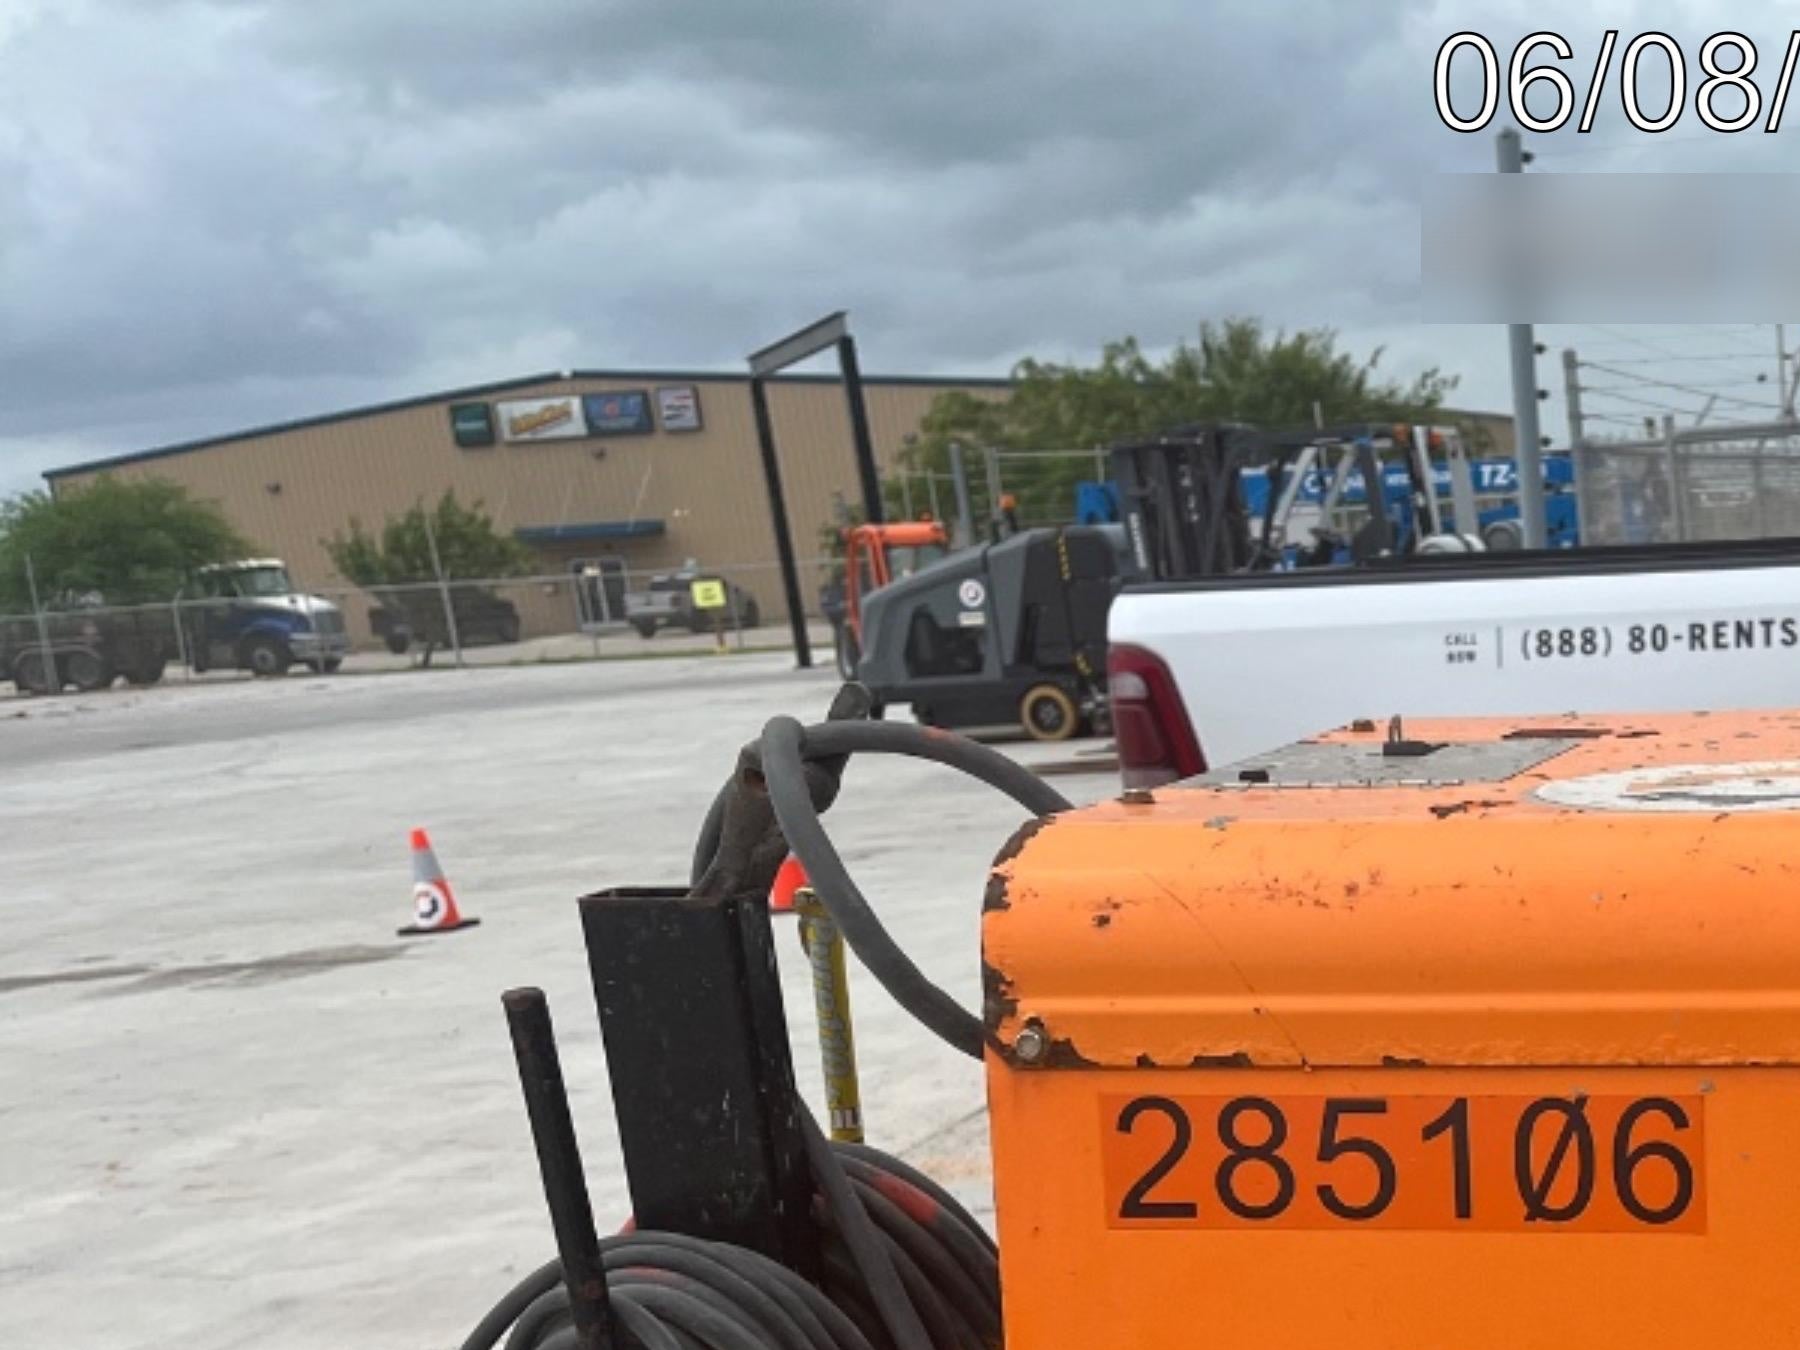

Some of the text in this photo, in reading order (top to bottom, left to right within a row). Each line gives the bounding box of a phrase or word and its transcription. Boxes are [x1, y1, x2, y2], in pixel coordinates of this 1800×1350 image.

[1520, 617, 1799, 661] (888) 80-RENTS
[1116, 1095, 1694, 1224] 285106
